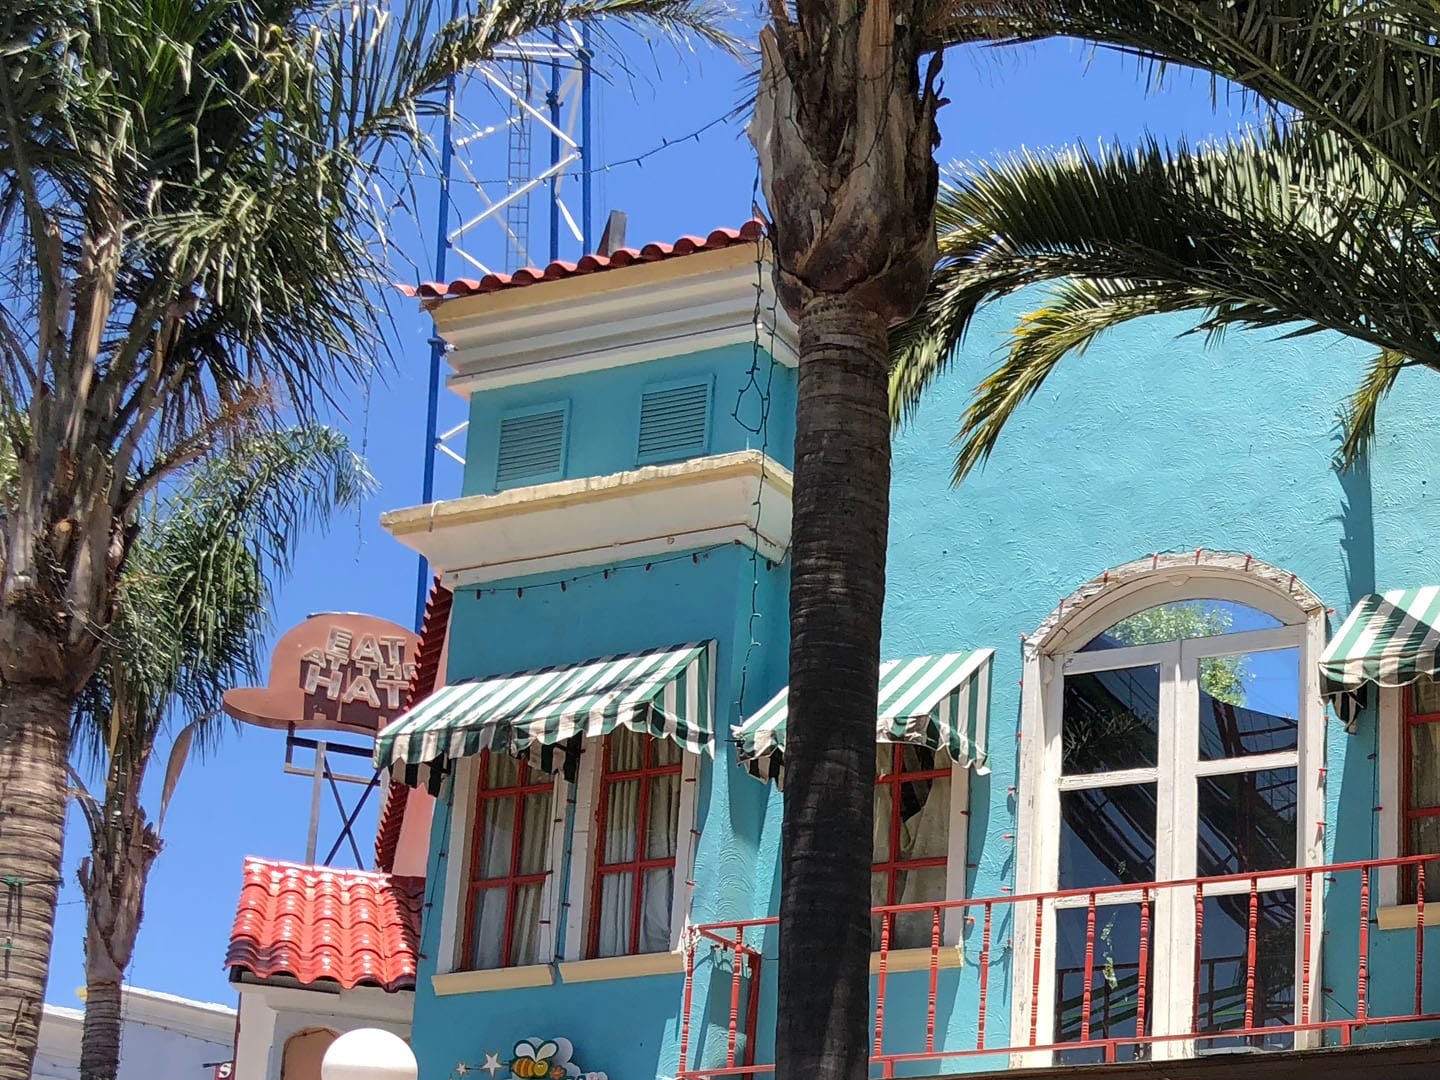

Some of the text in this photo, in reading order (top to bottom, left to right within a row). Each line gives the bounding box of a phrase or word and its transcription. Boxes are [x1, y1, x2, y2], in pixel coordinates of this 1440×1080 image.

[302, 647, 349, 671] AT
[325, 625, 407, 665] EAT
[304, 664, 410, 710] HAT
